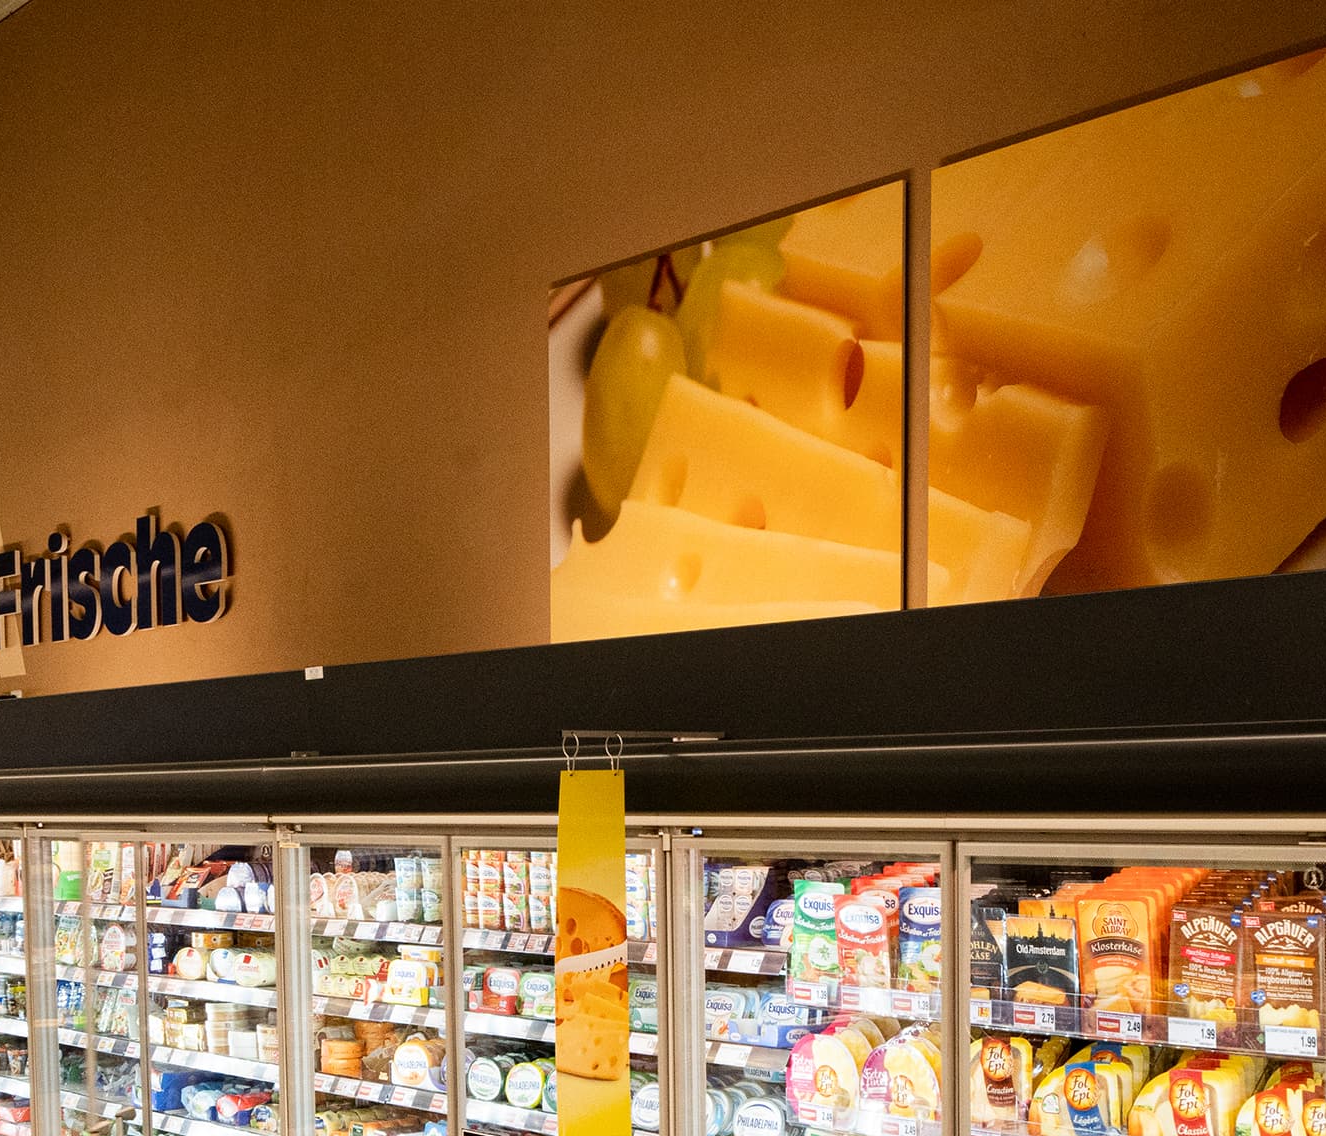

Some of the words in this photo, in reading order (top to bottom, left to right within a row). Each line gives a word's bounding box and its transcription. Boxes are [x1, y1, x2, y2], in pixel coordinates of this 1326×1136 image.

[845, 911, 879, 925] Exquisa
[1103, 918, 1128, 927] SAINT
[1101, 926, 1131, 935] ALBRAY
[1180, 916, 1237, 946] ALPGÄUER
[1254, 919, 1315, 948] ALPGÄUER
[1016, 944, 1028, 953] Old
[1028, 945, 1066, 956] Amsterdam
[1091, 942, 1143, 955] Klosterkäse
[489, 977, 518, 989] Exquisa
[527, 981, 549, 992] Exquisa
[706, 999, 733, 1014] Exquisa
[769, 1002, 796, 1016] Exquisa
[1070, 1076, 1089, 1090] Fol
[1071, 1089, 1091, 1102] Epi
[1176, 1086, 1197, 1098] Fol
[1178, 1098, 1198, 1113] Epi
[737, 1114, 779, 1129] PHILADELPHIA
